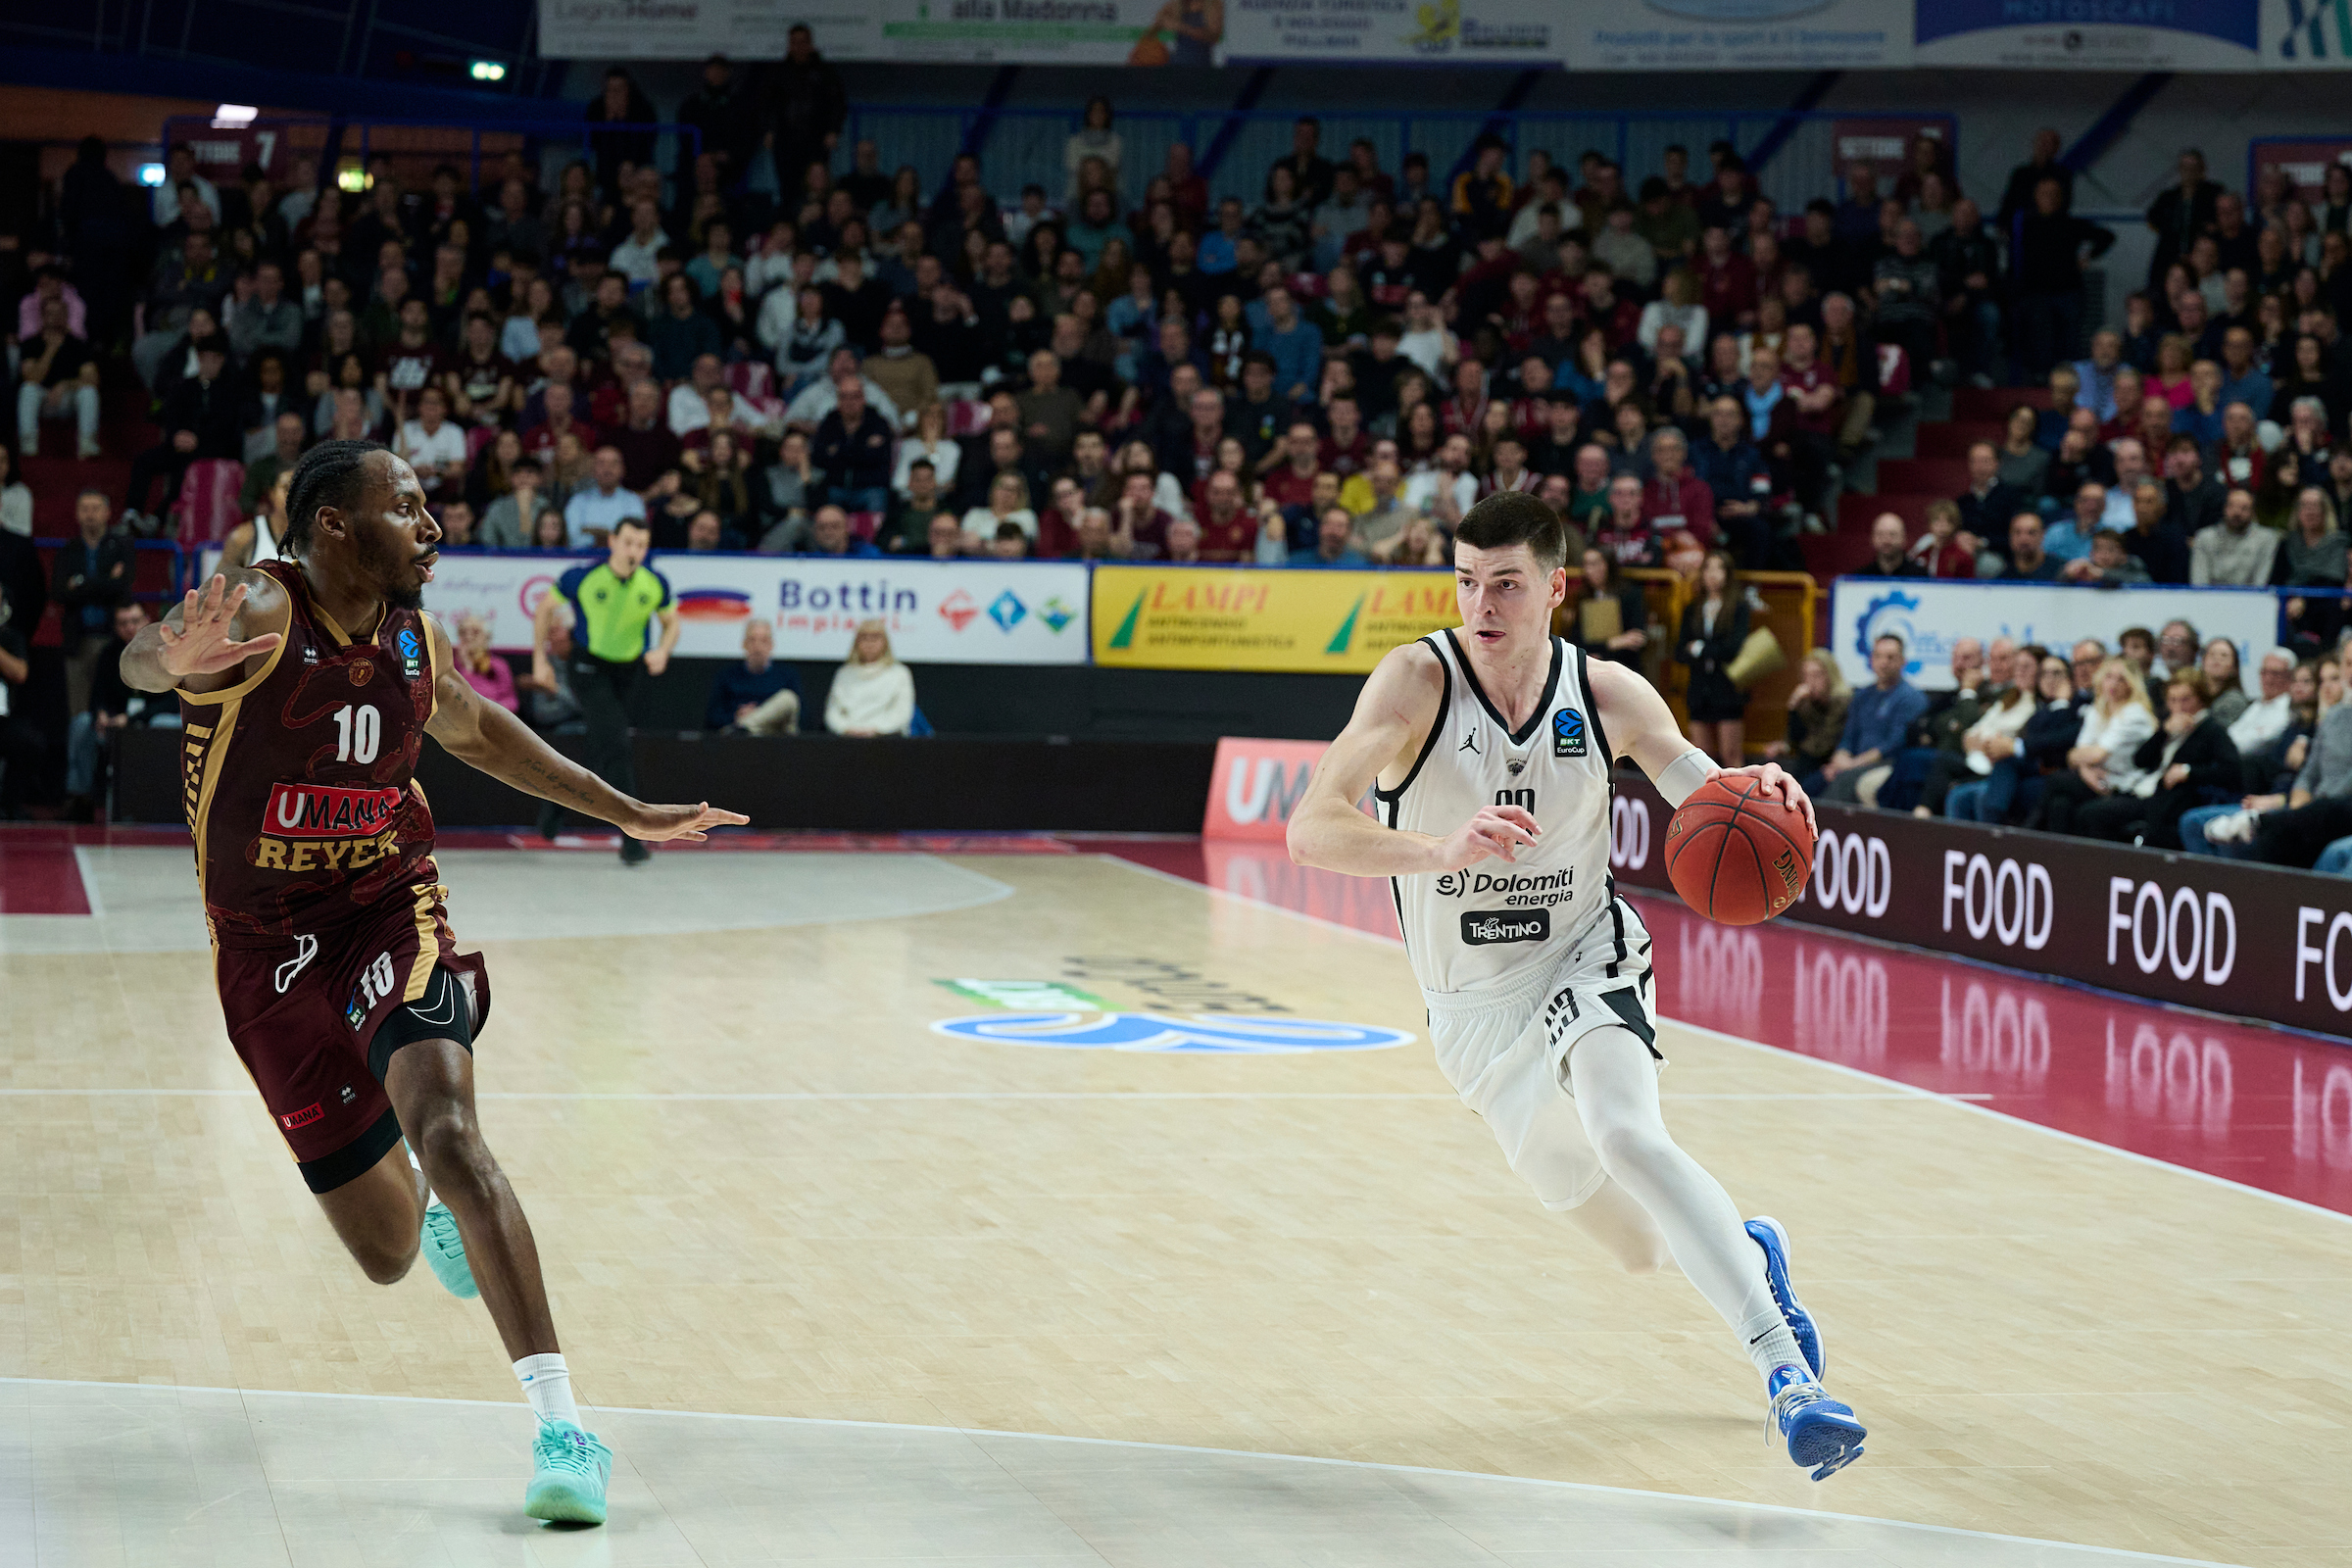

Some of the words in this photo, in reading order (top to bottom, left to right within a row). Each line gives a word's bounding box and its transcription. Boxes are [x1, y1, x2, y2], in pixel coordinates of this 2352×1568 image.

[255, 130, 276, 171] 7
[780, 579, 916, 611] Bottin
[1152, 581, 1270, 612] LAMPI
[1371, 587, 1459, 616] LAM
[333, 704, 381, 764] 10
[277, 791, 395, 830] UMANA
[255, 830, 401, 872] REYER
[1473, 865, 1574, 893] Dolomiti
[1799, 828, 1891, 918] OOD
[1505, 890, 1573, 906] energia
[1942, 850, 2053, 950] FOOD
[1469, 920, 1542, 940] TRENTINO
[2107, 876, 2236, 986] FOOD
[361, 951, 395, 1010] 10
[283, 1105, 320, 1127] UMANA
